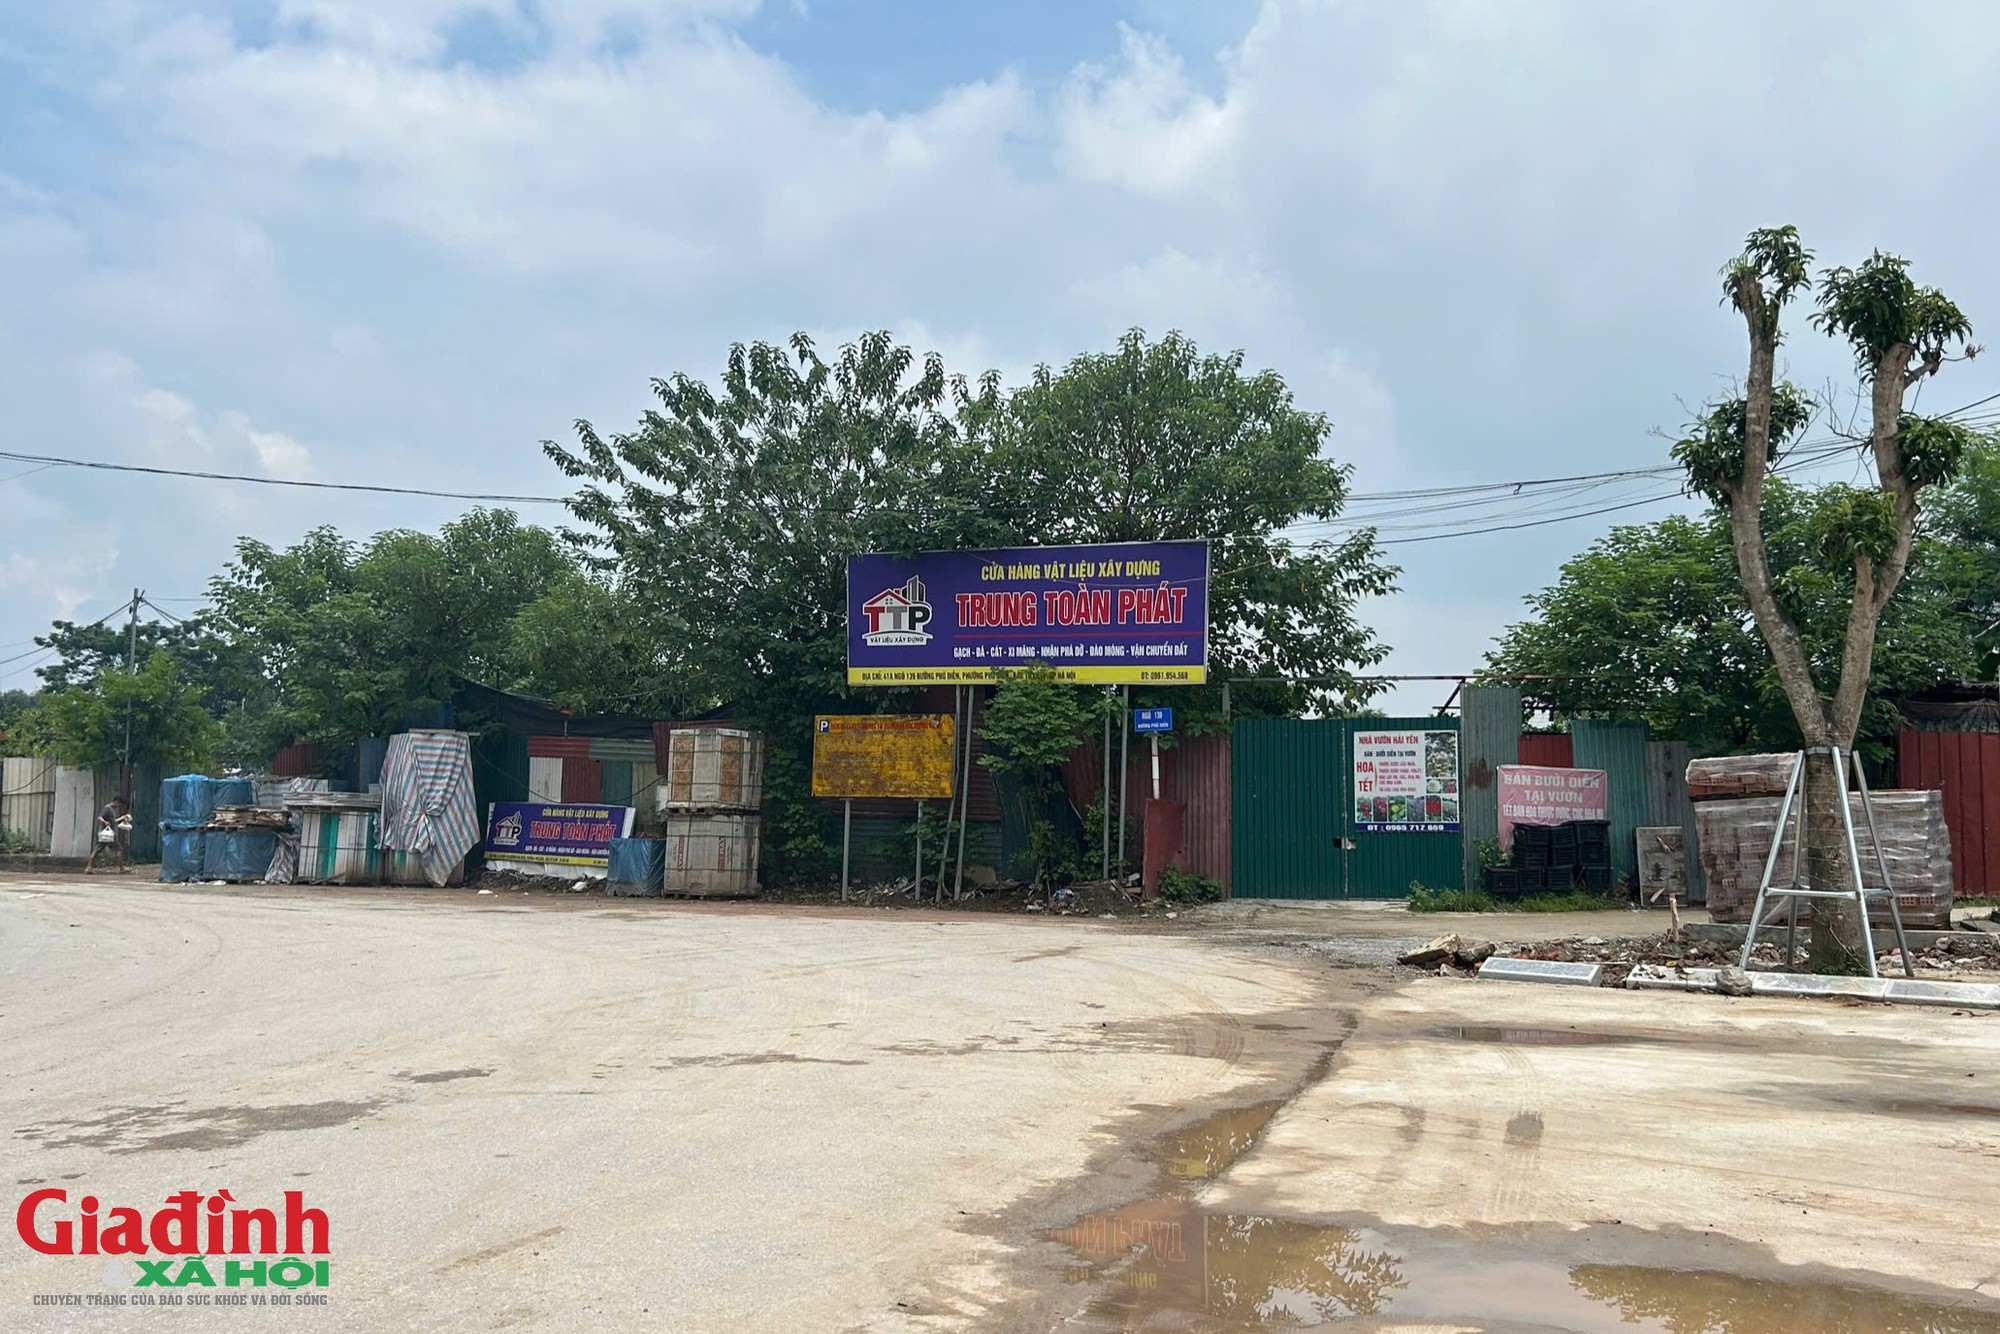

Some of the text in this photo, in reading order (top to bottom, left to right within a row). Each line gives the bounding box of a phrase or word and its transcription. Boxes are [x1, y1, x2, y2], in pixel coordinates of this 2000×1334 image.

[981, 558, 1160, 582] CỬA HÀNG VẬT LIỆU XÂY DỰNG
[956, 581, 1187, 627] TRUNG TOÀN PHÁT
[863, 606, 932, 632] TTP
[953, 646, 971, 660] GẠCH
[976, 645, 985, 658] ĐÁ
[990, 644, 1003, 658] CÁT
[1008, 646, 1015, 657] XI
[1016, 644, 1036, 657] MĂNG
[1041, 644, 1059, 659] NHẬN
[1060, 644, 1074, 657] PHÁ
[1089, 643, 1103, 657] ĐÀO
[1104, 643, 1125, 657] MÓNG
[1130, 643, 1145, 658] VẬN
[1145, 641, 1173, 656] CHUYỂN
[1174, 641, 1188, 656] ĐẤT
[1358, 735, 1372, 744] NHÀ
[1374, 734, 1391, 744] VƯỜN
[1406, 734, 1419, 744] YẾN
[1356, 761, 1374, 773] HOA
[1358, 777, 1374, 792] TẾT
[1504, 773, 1532, 786] BÁN
[1535, 773, 1565, 788] BƯỞI
[1524, 789, 1583, 804] TẠI VƯỜN
[529, 818, 617, 841] TRUNG TOÀN PHÁT
